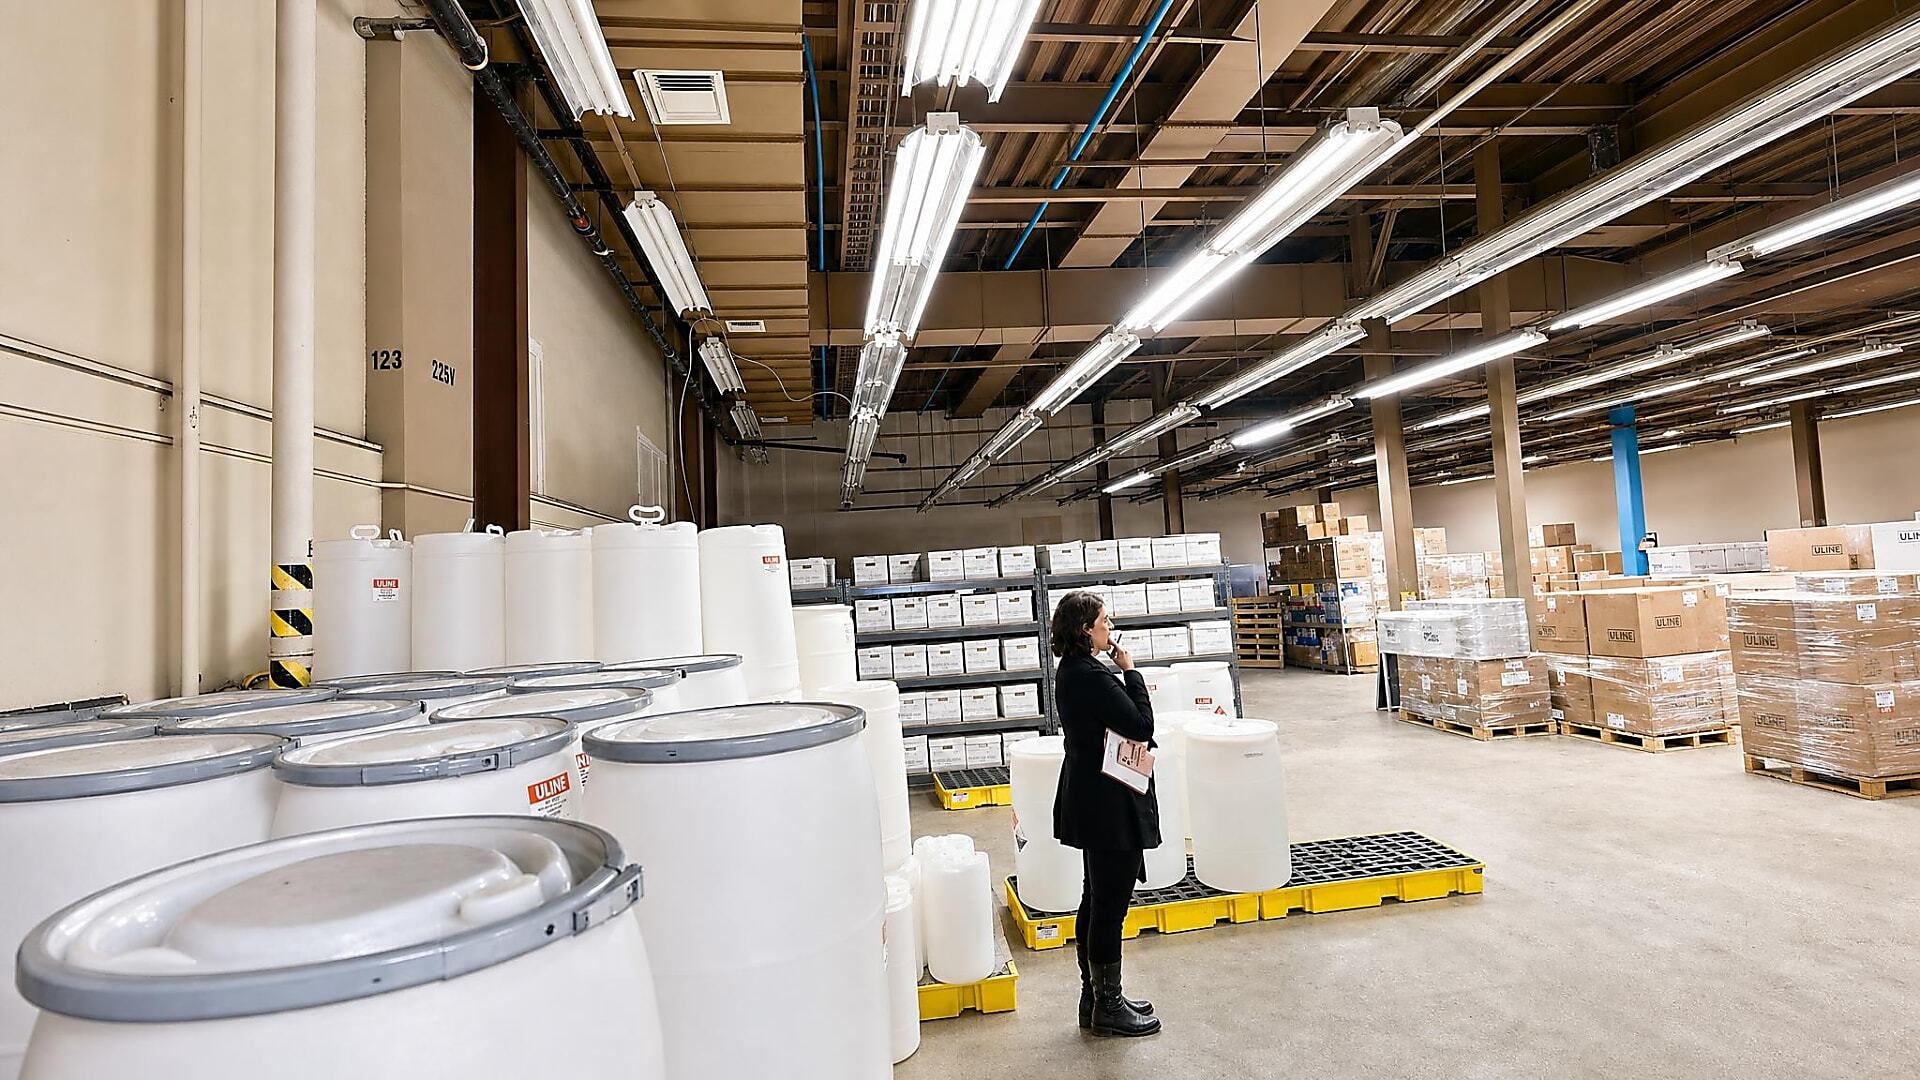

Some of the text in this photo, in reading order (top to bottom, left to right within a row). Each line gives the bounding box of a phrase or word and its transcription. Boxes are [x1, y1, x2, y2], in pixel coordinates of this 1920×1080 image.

[371, 350, 402, 370] 123
[431, 360, 456, 386] 225V
[1814, 546, 1841, 554] ULINE
[376, 580, 397, 588] ULINE
[1655, 616, 1681, 628] ULINE
[1609, 630, 1635, 642] ULINE
[1745, 634, 1777, 647] ULINE
[534, 775, 567, 800] ULINE
